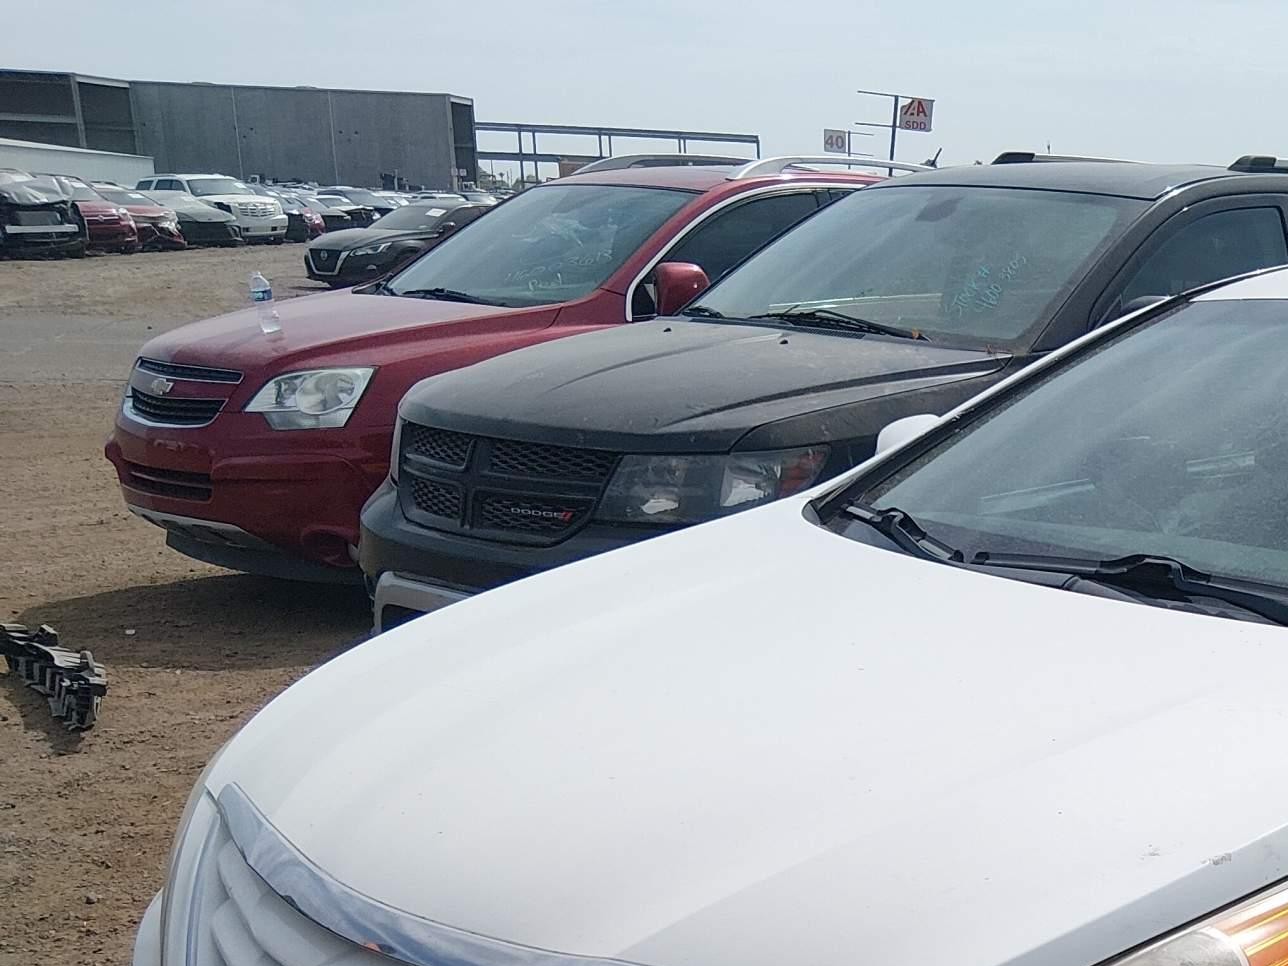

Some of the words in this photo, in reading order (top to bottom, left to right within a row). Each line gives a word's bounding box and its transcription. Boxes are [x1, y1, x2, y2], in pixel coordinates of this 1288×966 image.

[904, 120, 926, 130] SDD
[825, 135, 845, 150] 40
[510, 506, 565, 519] DODGE
